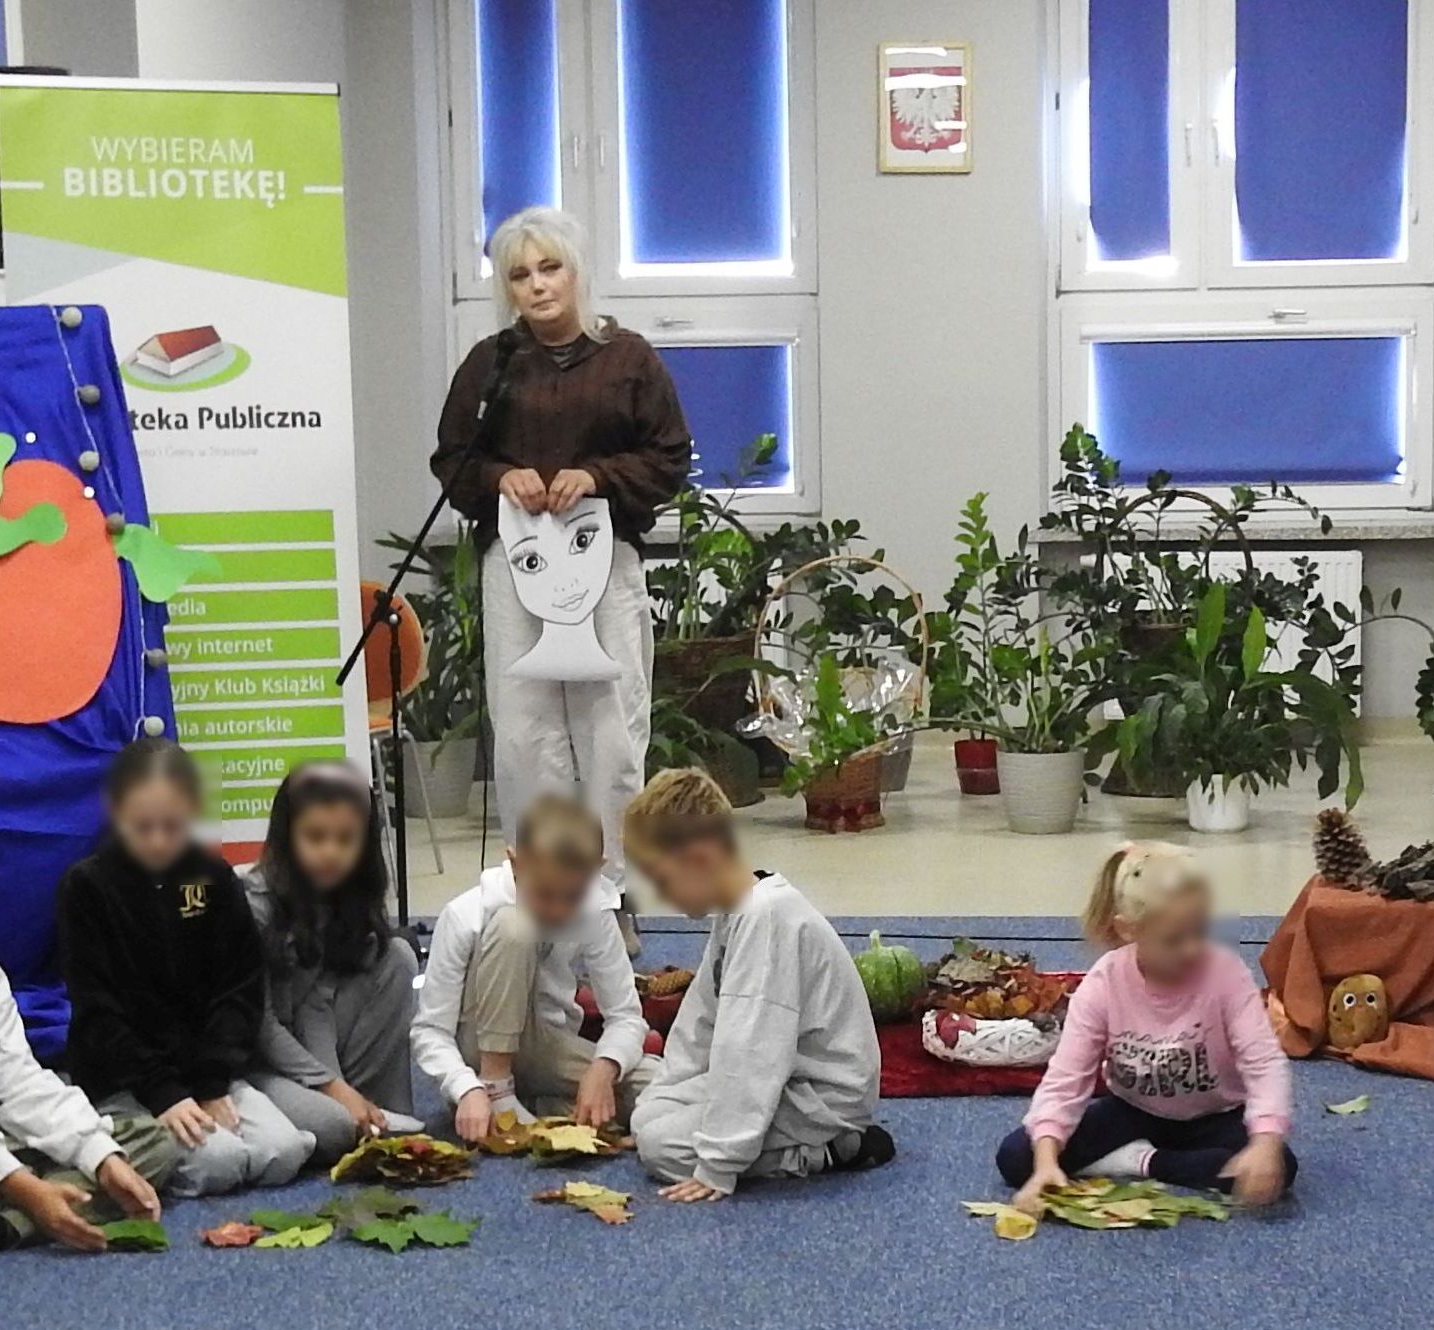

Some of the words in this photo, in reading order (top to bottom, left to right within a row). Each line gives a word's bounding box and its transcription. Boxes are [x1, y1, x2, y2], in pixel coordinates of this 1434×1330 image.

[90, 135, 254, 164] WYBIERAM
[63, 167, 286, 209] BIBLIOTEKĘ!
[128, 407, 189, 431] teka
[198, 404, 323, 430] Publiczna
[167, 598, 207, 616] edia
[166, 641, 192, 660] wy
[197, 637, 274, 655] internet
[171, 681, 209, 701] yjny
[216, 676, 256, 695] Klub
[262, 674, 325, 696] Książki
[205, 715, 293, 735] autorskie
[222, 755, 285, 776] acyjne
